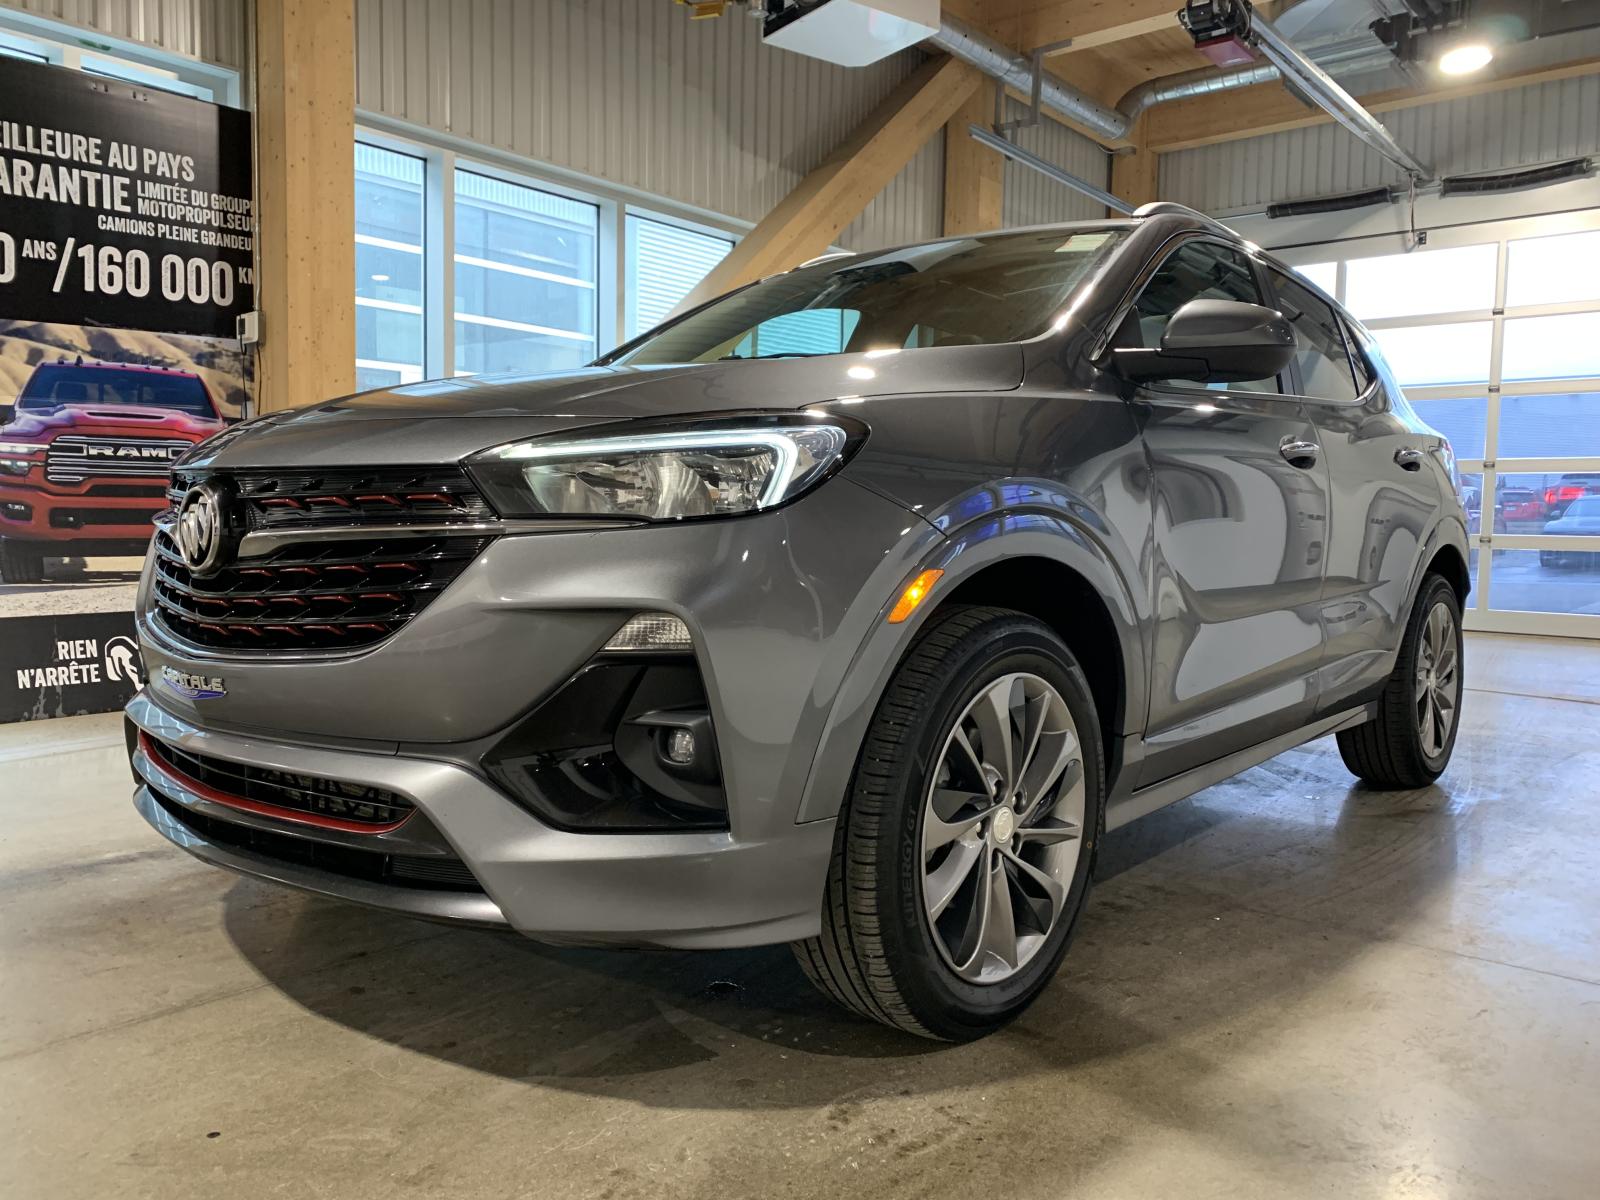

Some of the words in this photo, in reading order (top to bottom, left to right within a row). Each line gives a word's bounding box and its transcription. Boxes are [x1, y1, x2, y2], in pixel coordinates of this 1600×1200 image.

[0, 120, 103, 166] ILLEURE
[107, 141, 138, 171] AU
[143, 147, 195, 182] PAYS
[137, 180, 189, 205] LIMITÉE
[191, 189, 209, 208] DU
[97, 214, 155, 237] CAMIONS
[158, 223, 199, 243] PLEINE
[22, 238, 57, 261] ANS
[161, 253, 234, 307] 000
[88, 445, 167, 458] RAM
[57, 639, 98, 660] RIEN
[16, 661, 101, 689] N'ARRÊTE
